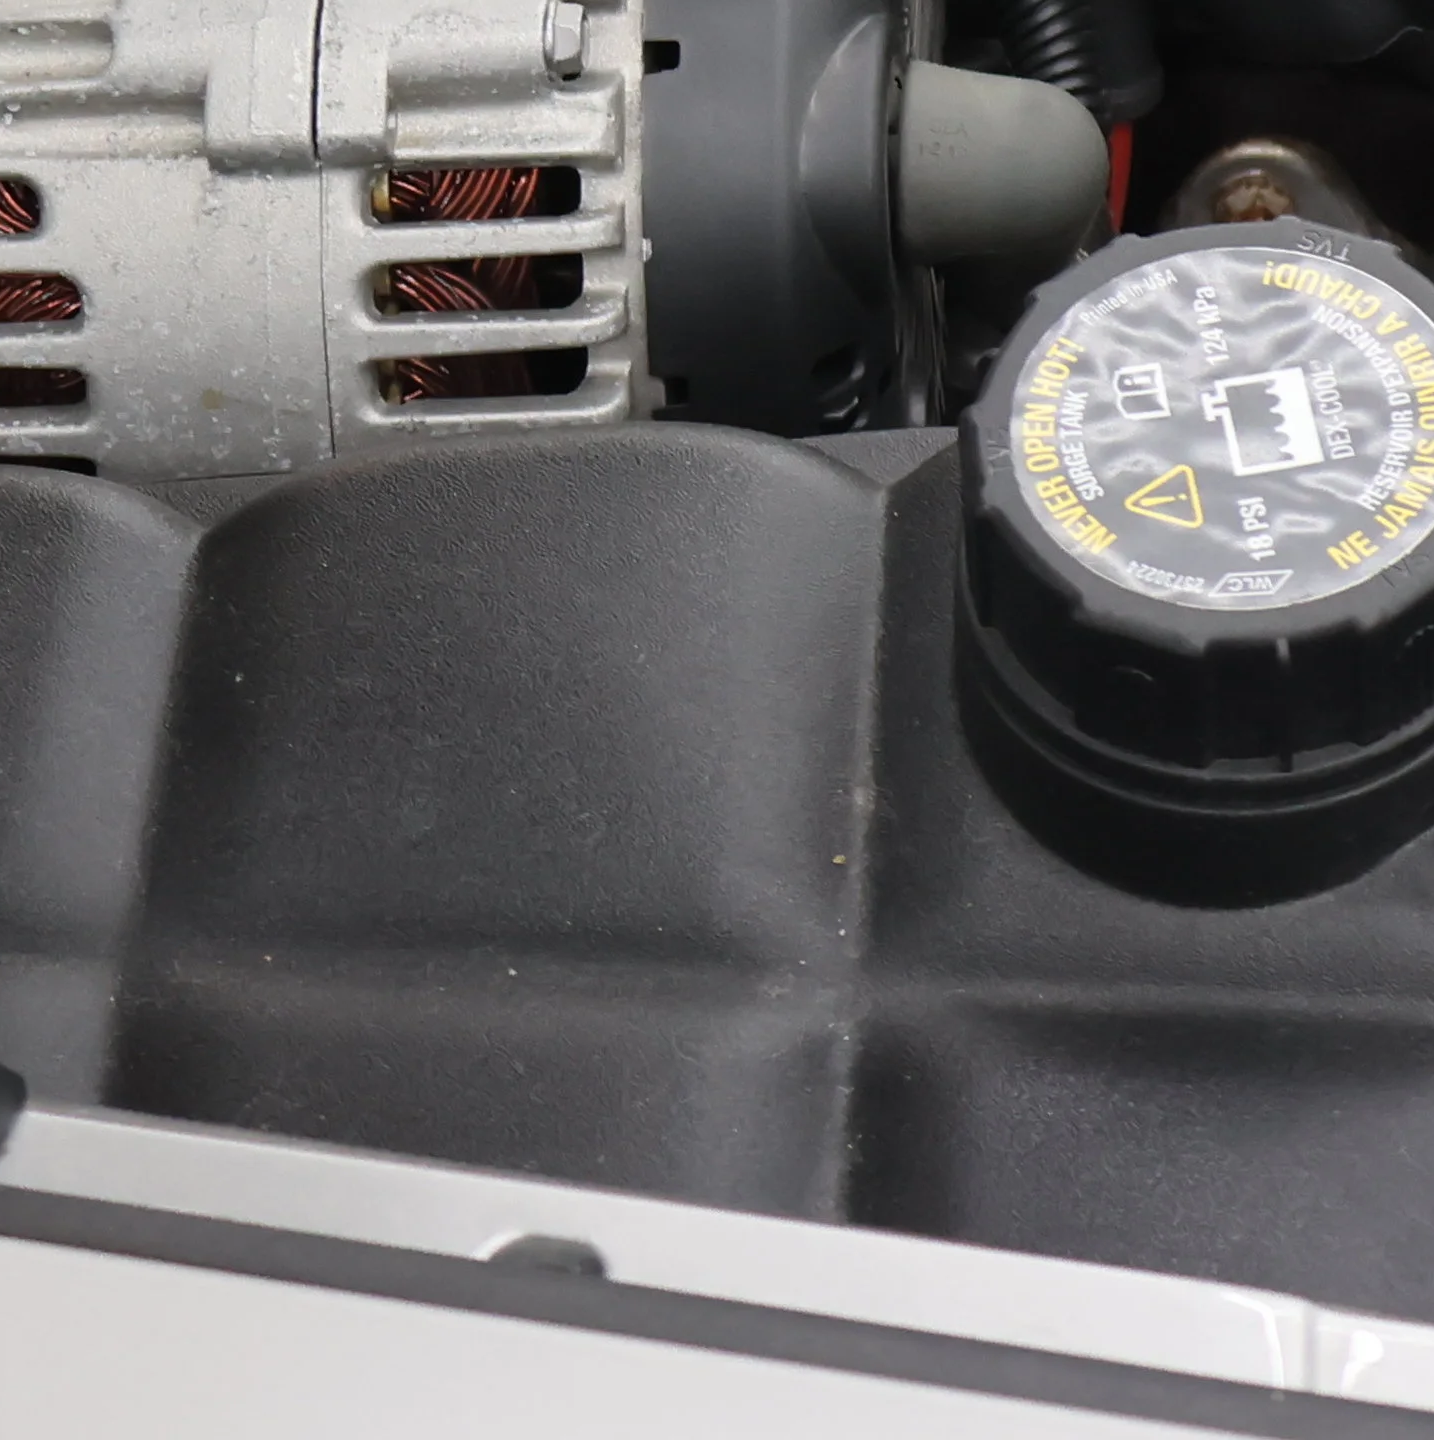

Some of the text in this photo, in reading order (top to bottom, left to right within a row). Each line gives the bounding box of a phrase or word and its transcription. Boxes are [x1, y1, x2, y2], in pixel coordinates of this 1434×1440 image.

[1296, 229, 1351, 262] TVS
[1142, 268, 1179, 290] USA
[1261, 259, 1383, 320] CHAUD!
[1192, 285, 1230, 367] 124 kPa
[1375, 310, 1410, 337] A
[1311, 304, 1415, 512] RESERVOIR D'EXPANSION
[1022, 336, 1118, 556] NEVER OPEN HOT!
[1060, 388, 1105, 502] SURGE TANK
[1237, 496, 1277, 562] 18 PSI
[1326, 529, 1380, 571] NE
[1226, 575, 1274, 593] WLC
